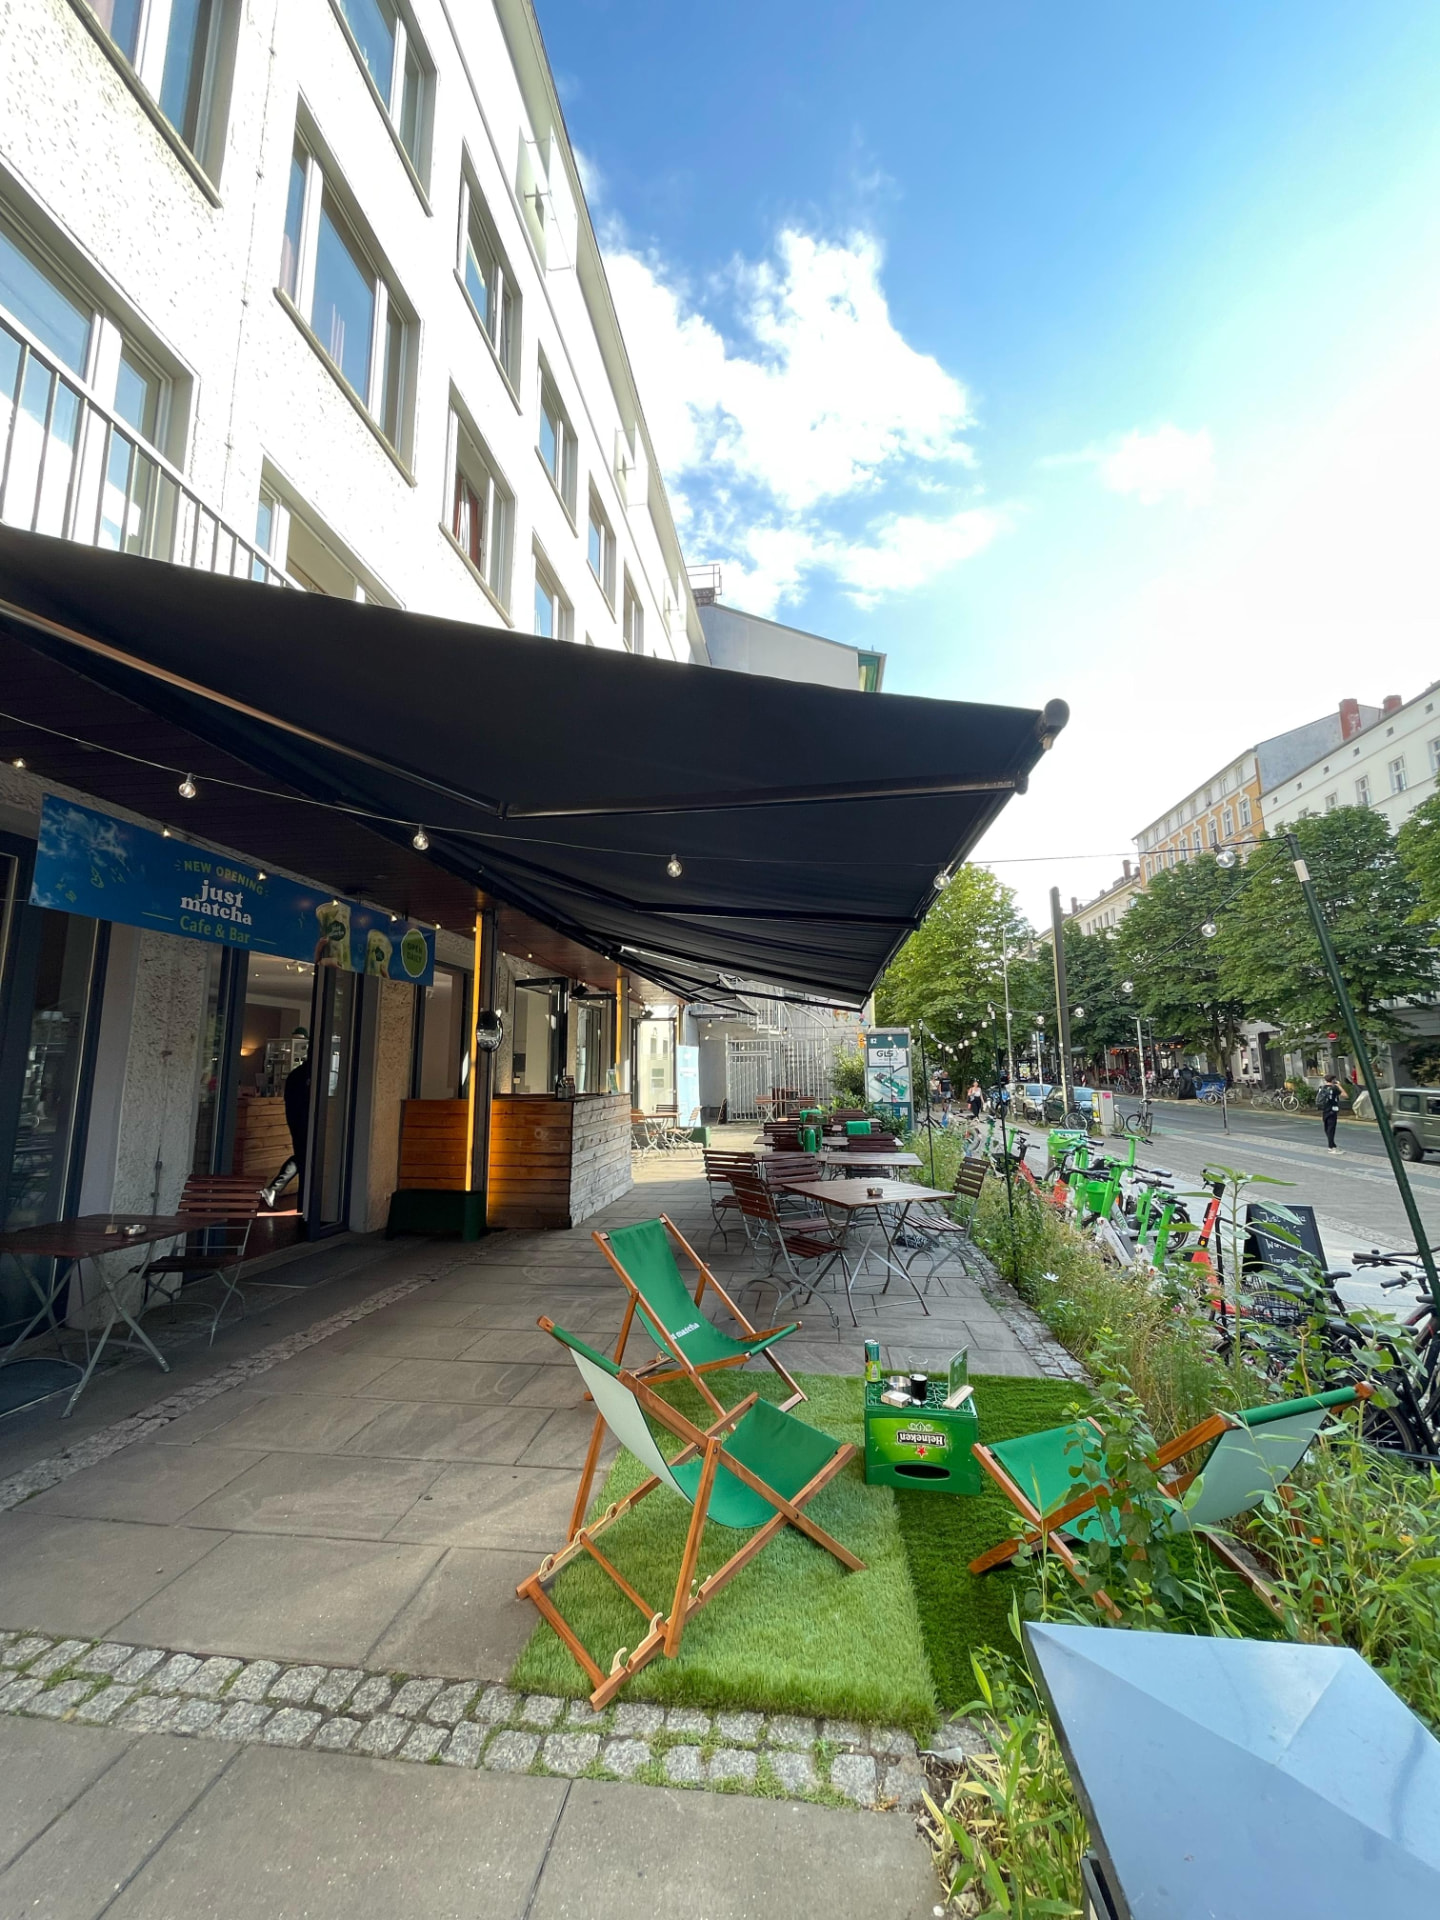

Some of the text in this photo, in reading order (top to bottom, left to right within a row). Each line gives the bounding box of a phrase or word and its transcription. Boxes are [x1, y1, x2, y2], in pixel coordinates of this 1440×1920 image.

[184, 860, 264, 896] NEW OPENING
[199, 880, 244, 908] just
[180, 897, 252, 926] matcha
[180, 915, 251, 944] Cafe & Bar
[876, 1050, 894, 1058] GLS
[899, 1433, 944, 1445] Heineken
